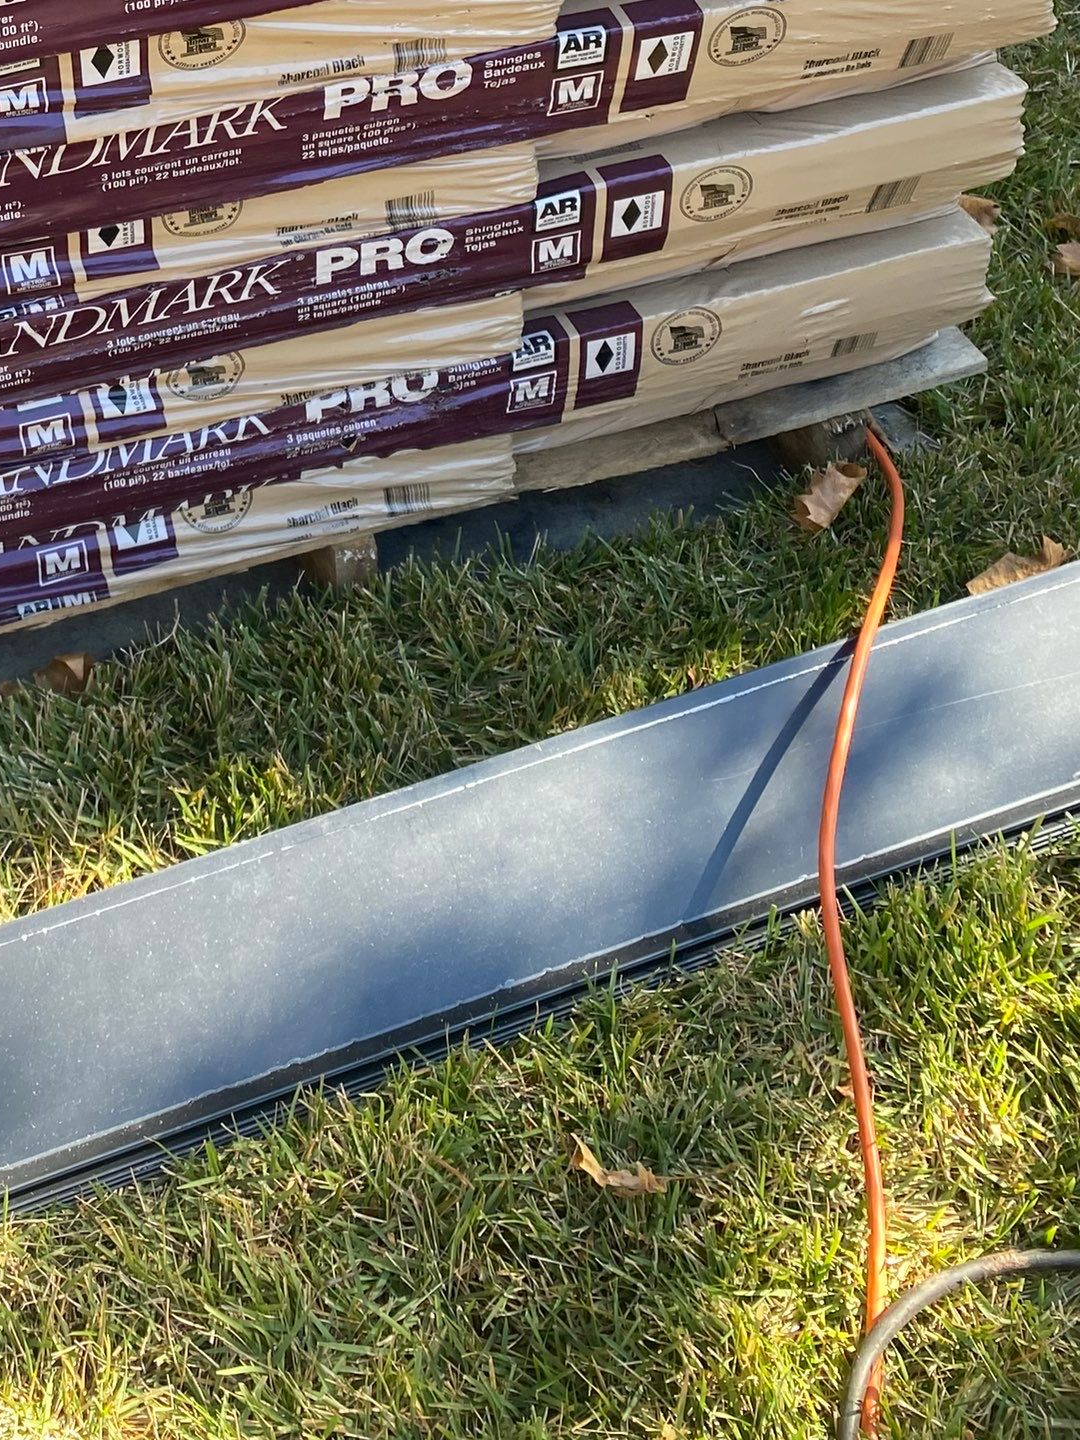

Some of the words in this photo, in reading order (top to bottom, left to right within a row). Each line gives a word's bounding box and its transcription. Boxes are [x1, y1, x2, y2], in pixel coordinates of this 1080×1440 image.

[561, 32, 602, 55] AR
[484, 61, 546, 79] Bardeaux
[323, 60, 472, 120] PRO
[556, 77, 598, 105] M
[313, 228, 455, 284] PRO
[464, 240, 496, 253] Tejas
